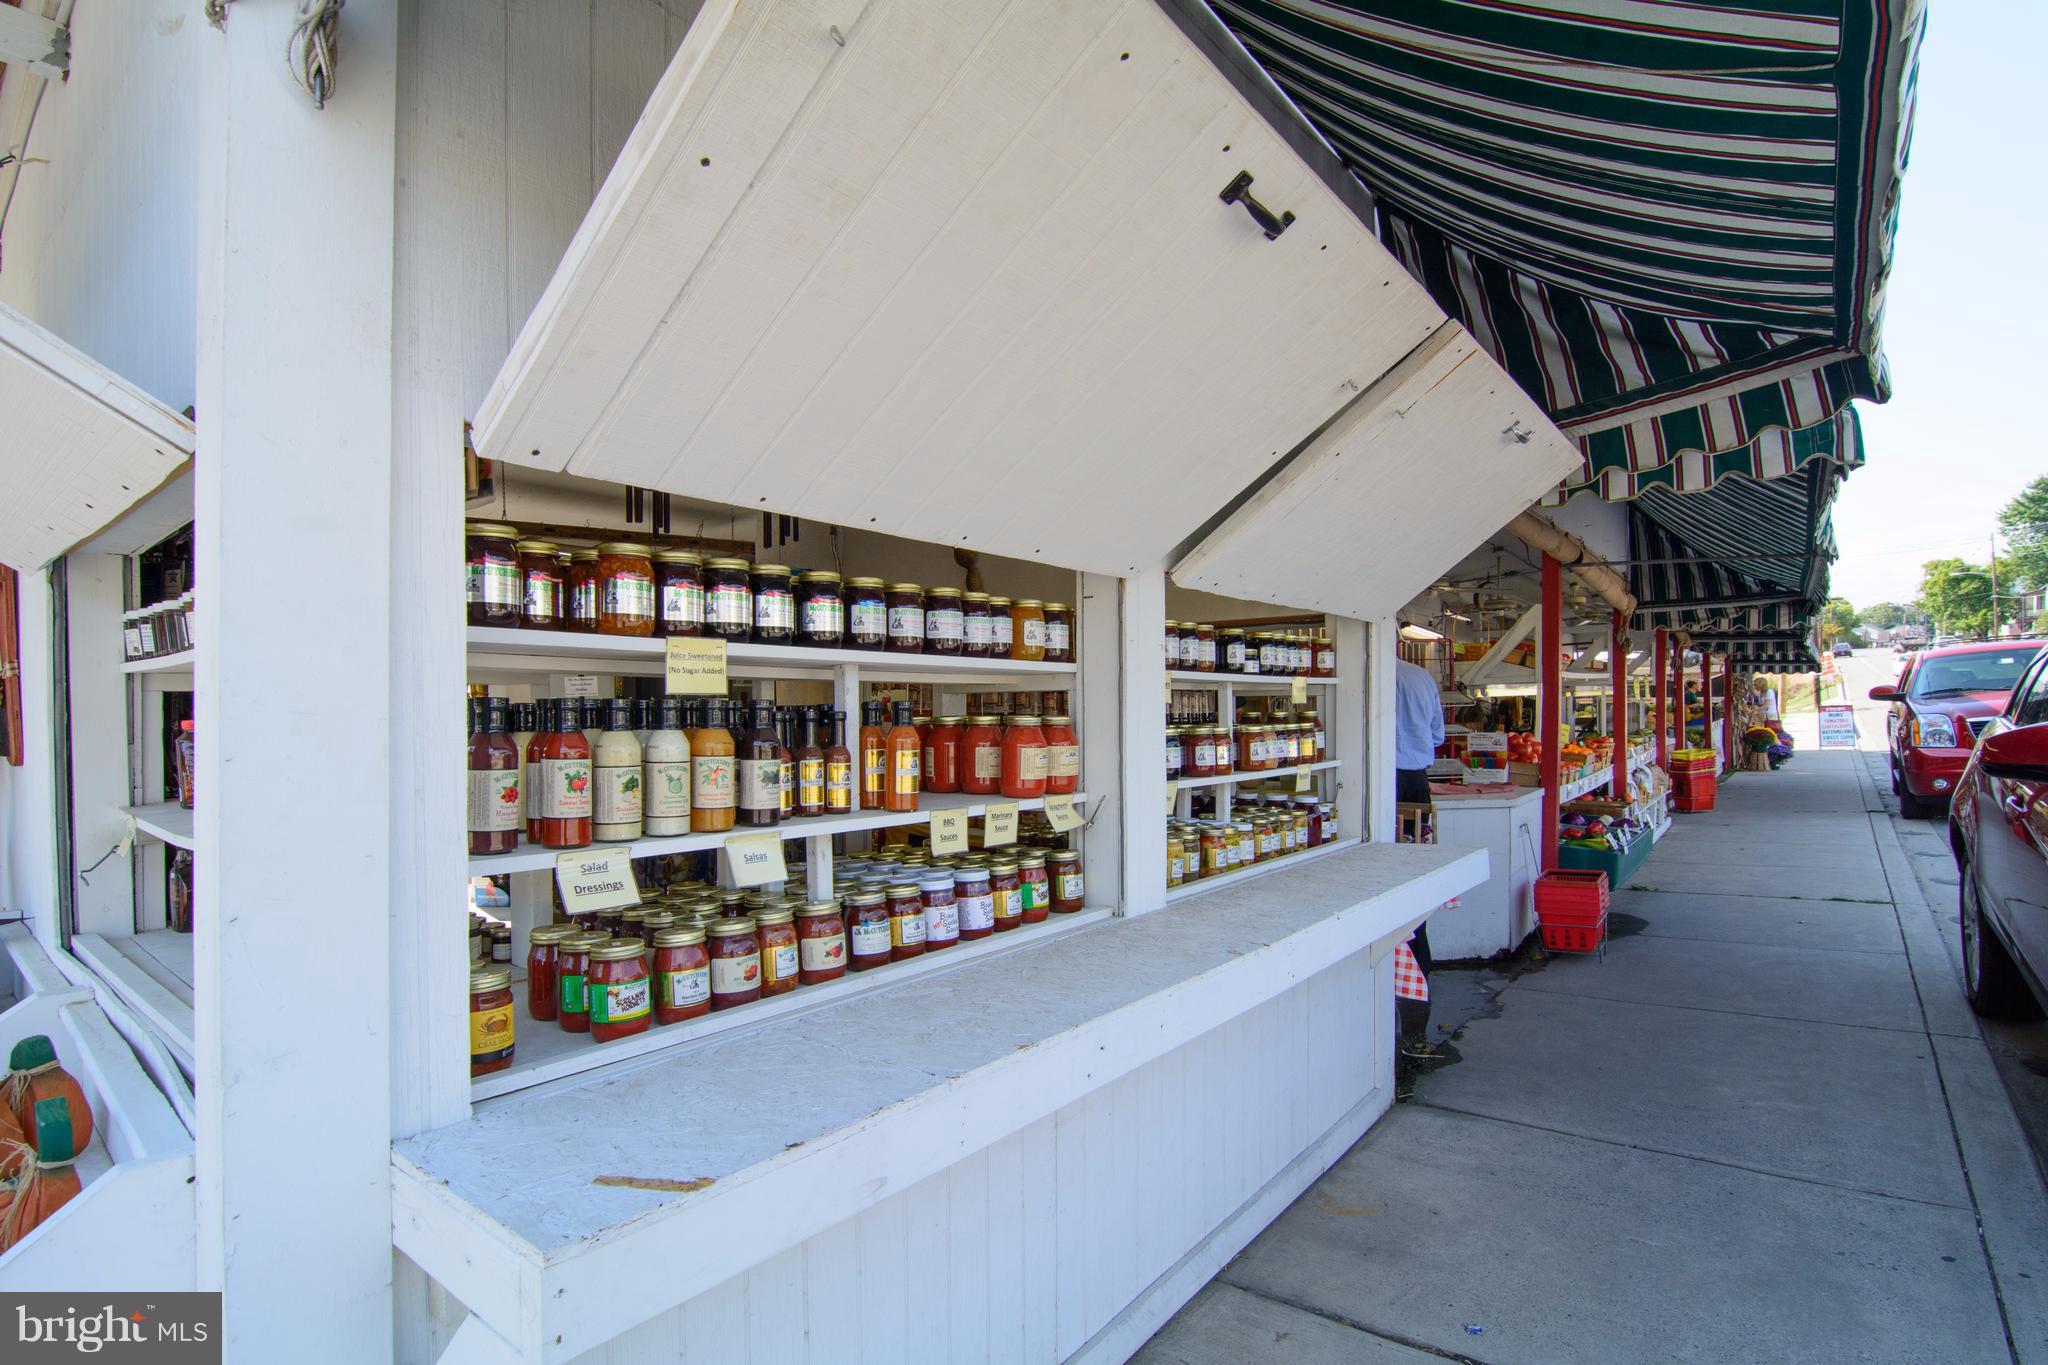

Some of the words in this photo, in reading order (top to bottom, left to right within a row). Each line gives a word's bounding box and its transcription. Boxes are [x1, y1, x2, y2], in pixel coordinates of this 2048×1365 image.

[687, 652, 723, 660] Sweetened
[682, 667, 700, 675] Sugar
[701, 667, 725, 675] Added)
[943, 818, 955, 826] BBQ
[994, 824, 1009, 832] Sauce
[940, 833, 958, 842] Sauces
[743, 853, 768, 862] Salsas
[580, 860, 609, 874] Salad
[574, 881, 624, 894] Dressings
